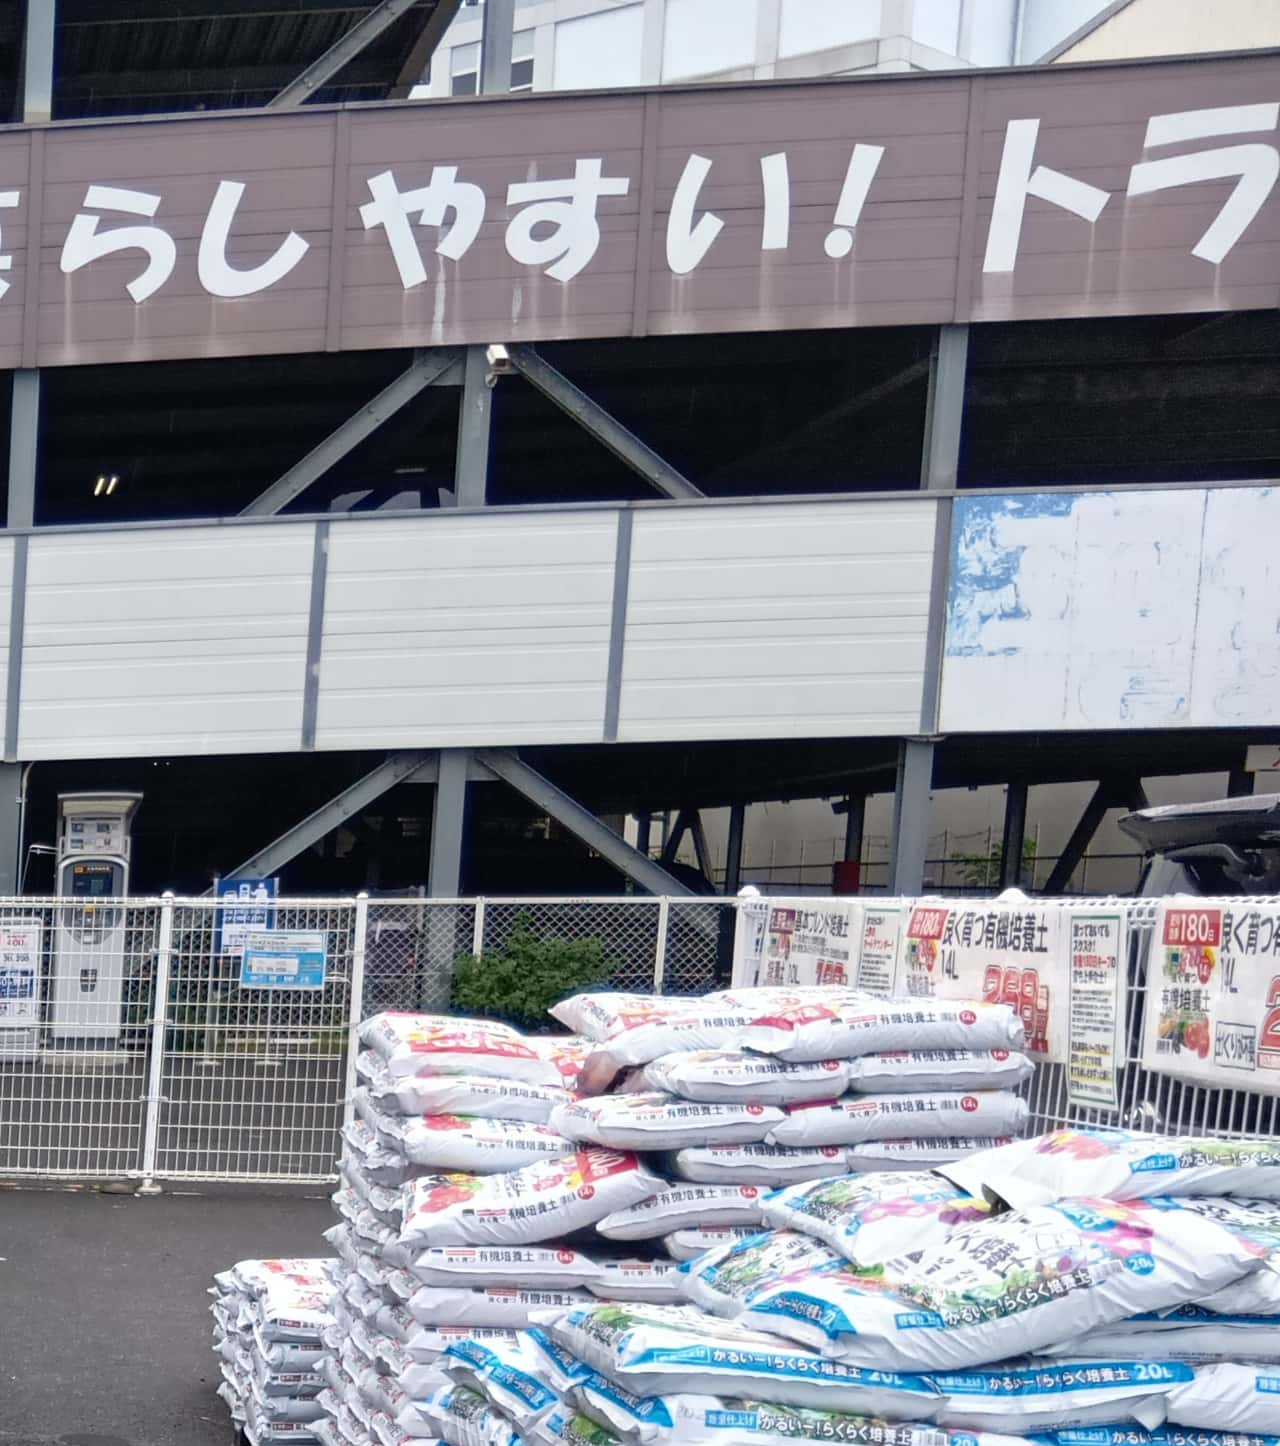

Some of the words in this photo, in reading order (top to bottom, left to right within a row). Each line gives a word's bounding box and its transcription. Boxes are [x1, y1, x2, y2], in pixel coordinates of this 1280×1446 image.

[943, 911, 1049, 953] 良く育つ有機培養土
[880, 1012, 936, 1024] 有機培養土
[667, 1106, 723, 1118] 有機培養土
[879, 1101, 937, 1113] 有機培養土
[479, 1250, 534, 1263] 有機培養土
[713, 1350, 862, 1379] かるいー!らくらく培養土
[1134, 1364, 1173, 1381] 20L
[760, 1414, 913, 1446] かるいー!らくらく培養土
